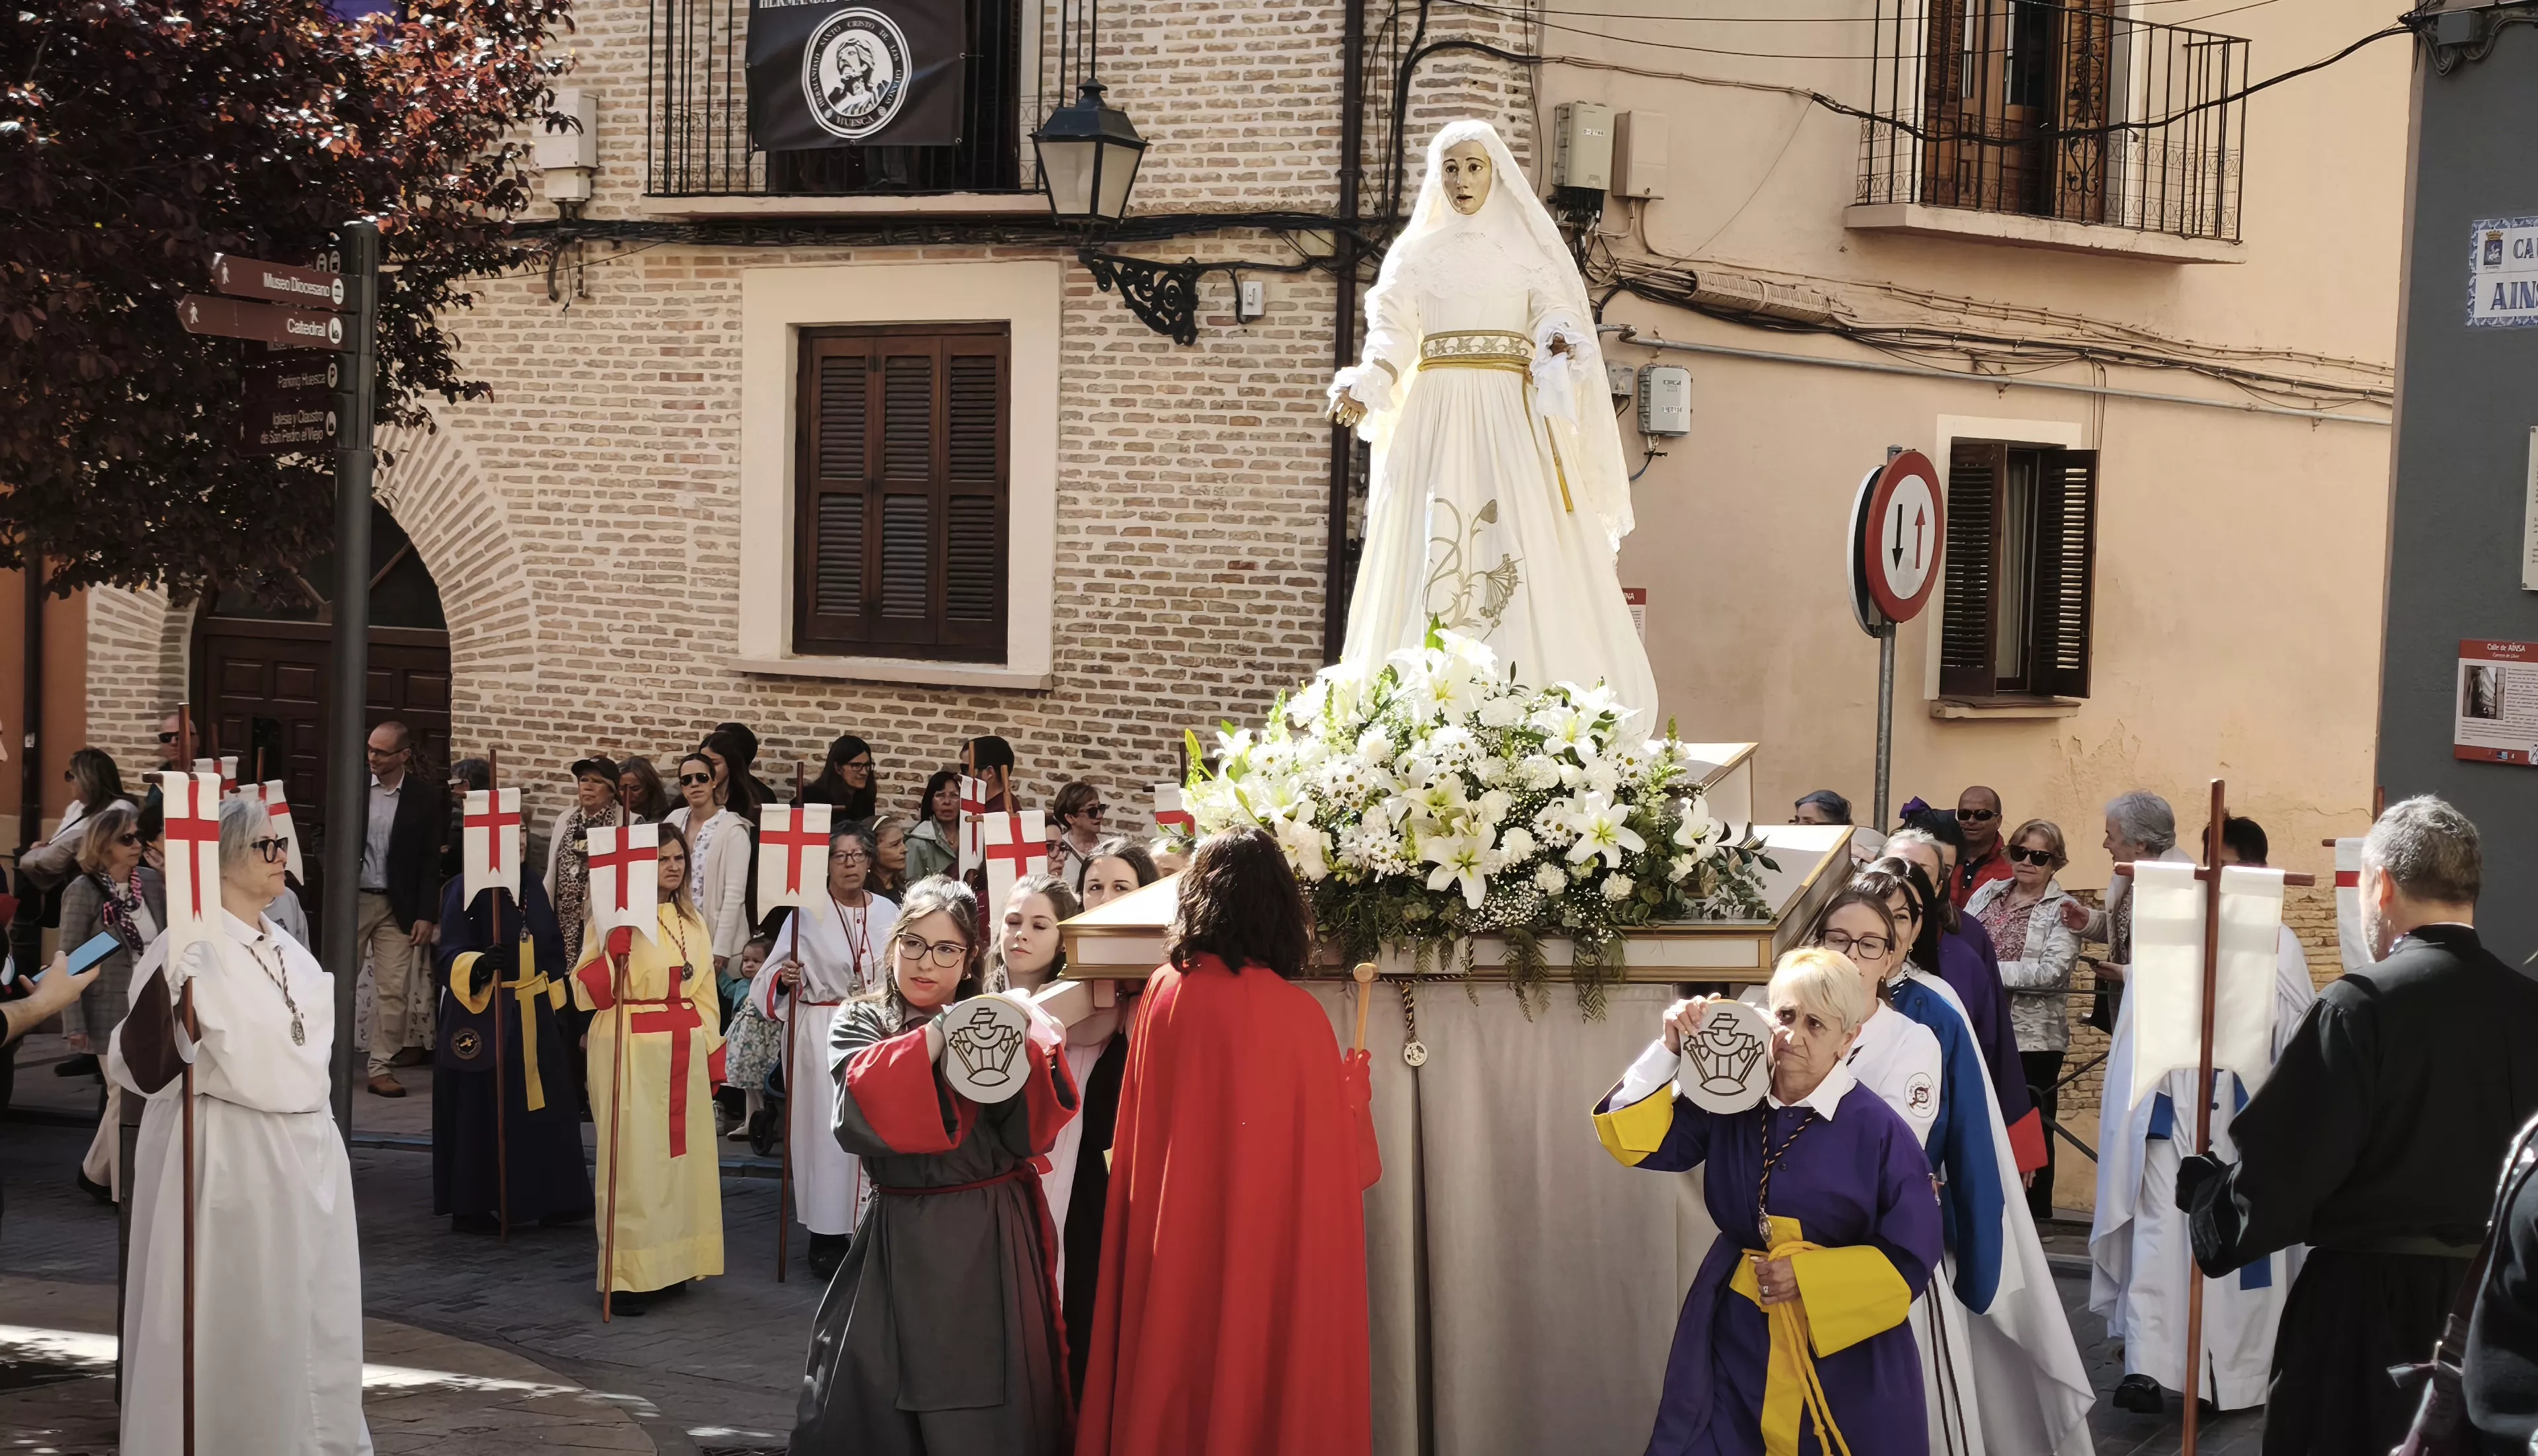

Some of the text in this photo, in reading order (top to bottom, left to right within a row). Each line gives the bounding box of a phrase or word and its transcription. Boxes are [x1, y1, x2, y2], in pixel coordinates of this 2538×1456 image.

[847, 20, 876, 30] CRISTO
[837, 116, 875, 127] HUESCA
[2513, 238, 2538, 259] CA
[263, 272, 329, 297] Museo Diocesano
[2490, 281, 2538, 310] AIN
[287, 318, 326, 337] Catedral
